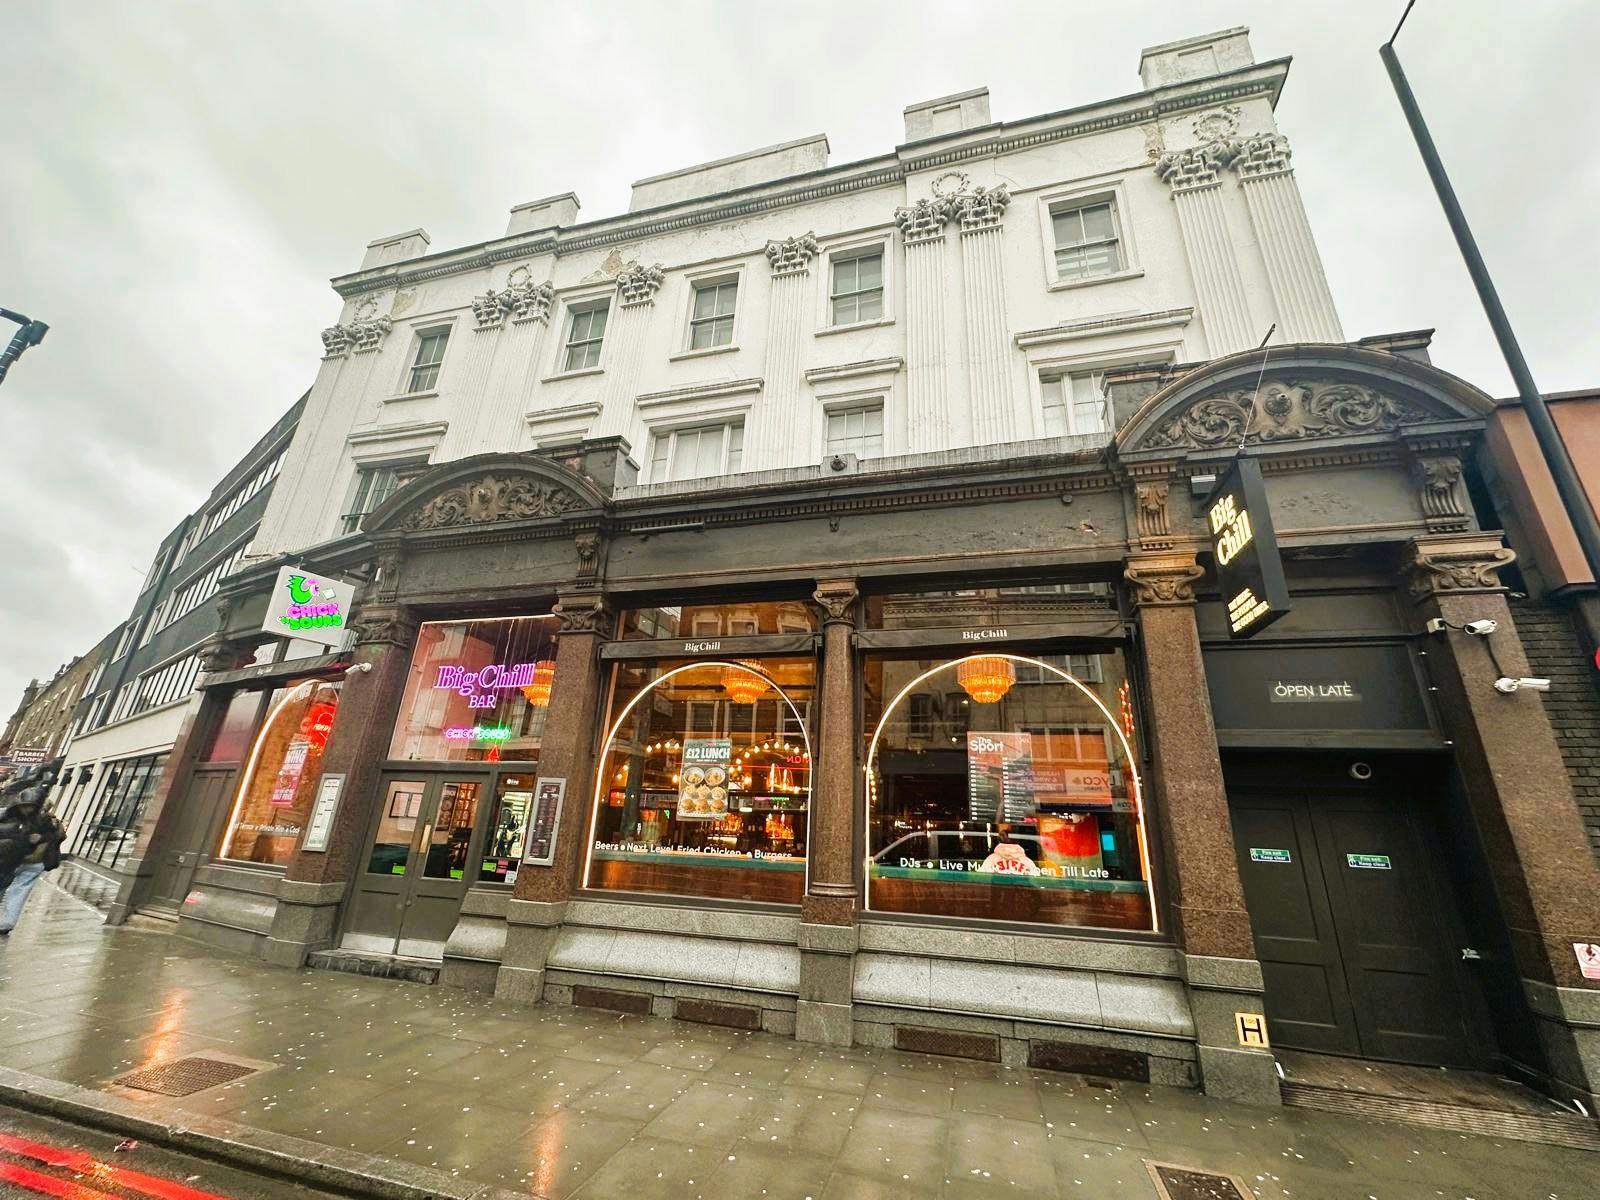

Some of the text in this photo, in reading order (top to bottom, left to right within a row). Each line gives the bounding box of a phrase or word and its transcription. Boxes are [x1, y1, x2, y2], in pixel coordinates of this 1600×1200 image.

[1210, 495, 1236, 534] Big
[1217, 509, 1253, 565] Chill
[1275, 683, 1353, 696] OPEN LATE
[468, 695, 496, 709] BAR
[970, 740, 1004, 754] Sport
[977, 736, 992, 745] The
[685, 748, 730, 760] £12 LUNCH
[595, 841, 619, 851] Beers
[627, 843, 648, 853] Next
[900, 858, 921, 868] DJs
[940, 860, 963, 870] Live
[1060, 866, 1077, 876] Till
[1082, 867, 1109, 878] Late
[1240, 1017, 1263, 1043] H
